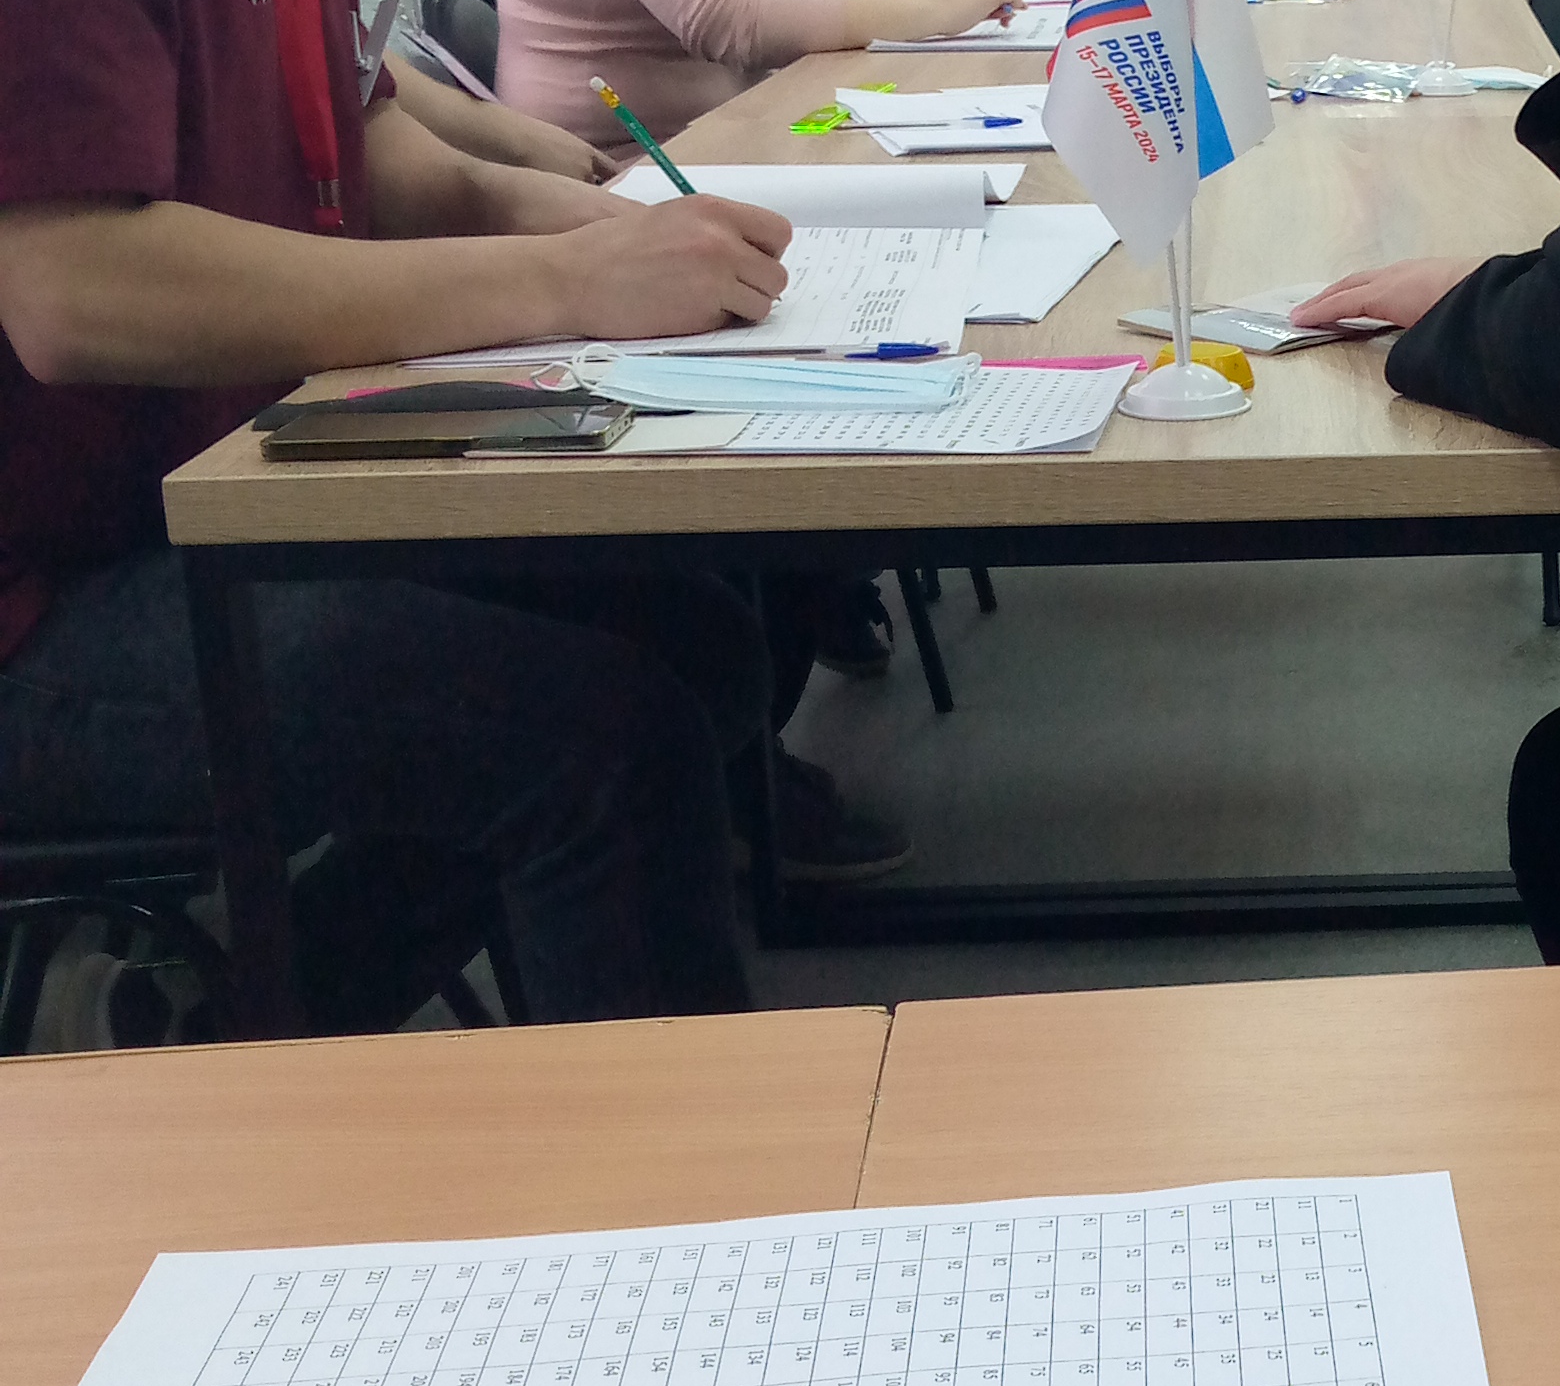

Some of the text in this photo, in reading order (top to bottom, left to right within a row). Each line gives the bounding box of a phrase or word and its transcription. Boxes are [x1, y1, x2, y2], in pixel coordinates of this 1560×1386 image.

[1098, 39, 1156, 114] РОССИИ
[1147, 31, 1185, 114] ВЫБОРЫ
[1125, 34, 1184, 154] ПРЕЗИДЕНТА
[1102, 83, 1142, 130] МАРТА
[1133, 129, 1160, 163] 2024
[1308, 1307, 1324, 1318] 14
[1079, 1323, 1095, 1335] 64
[795, 1345, 812, 1362] 124
[1313, 1345, 1329, 1356] 15
[602, 1359, 622, 1376] 164
[1078, 1363, 1094, 1374] 65
